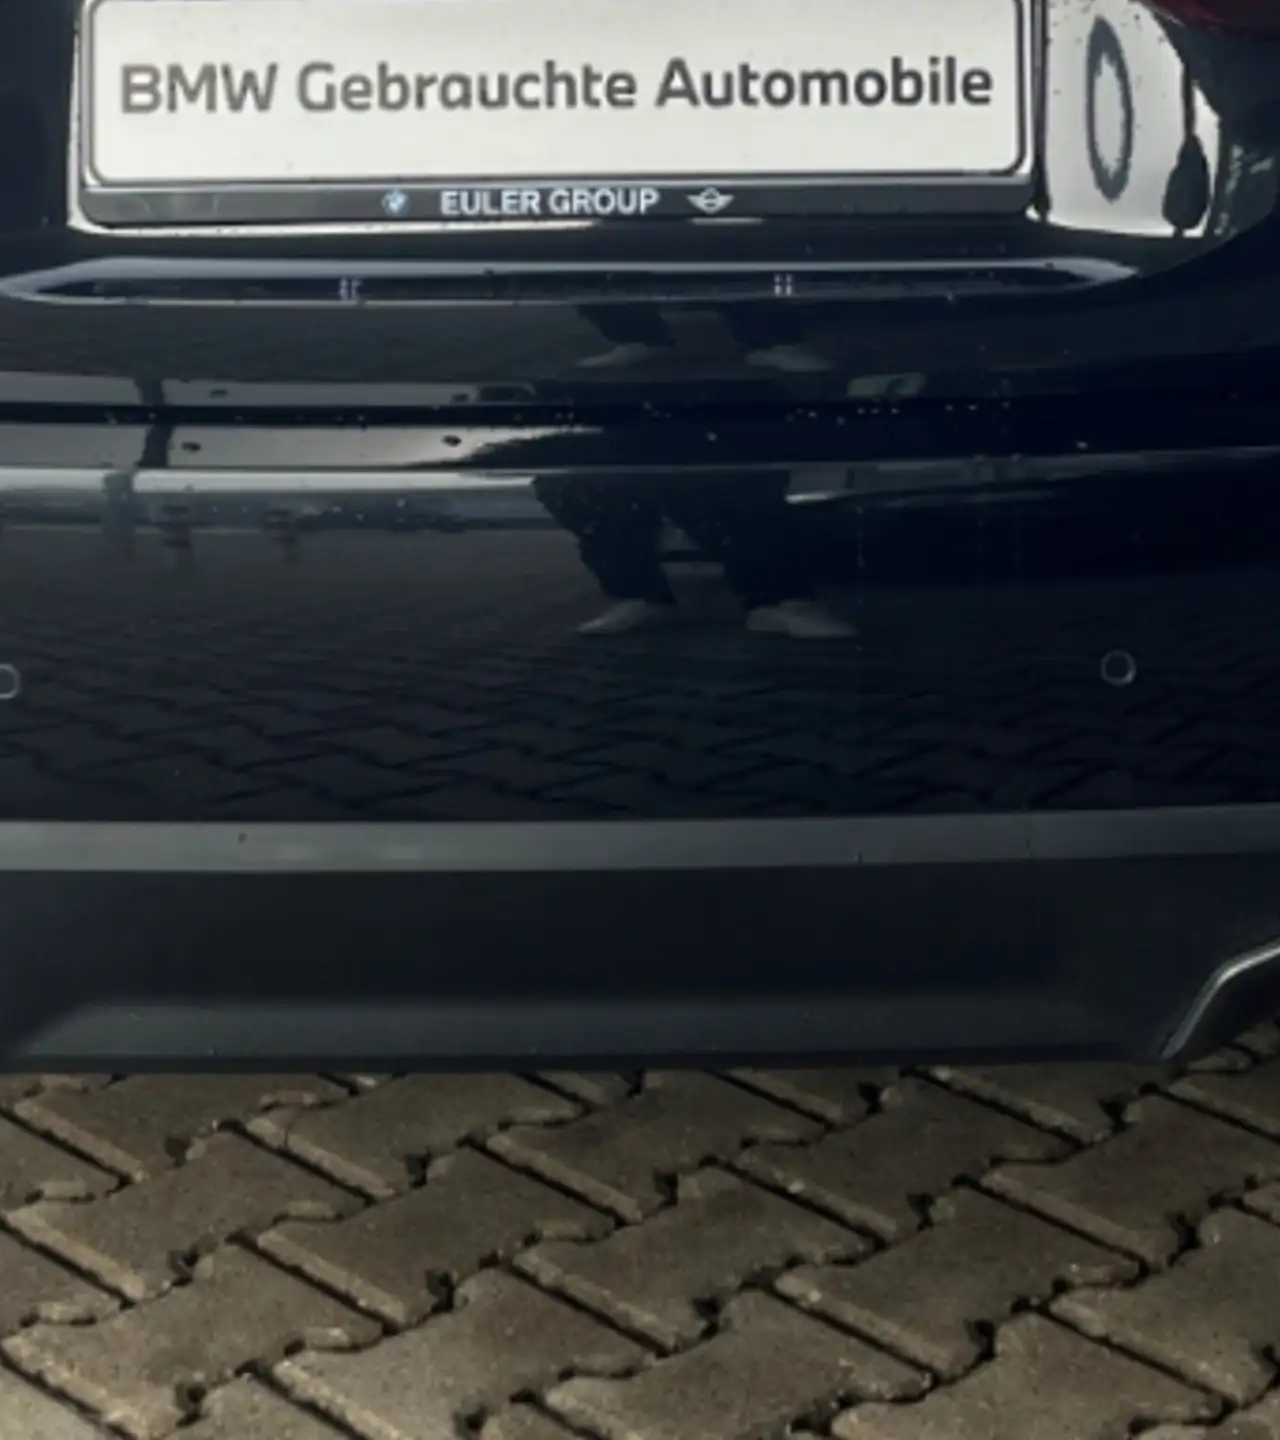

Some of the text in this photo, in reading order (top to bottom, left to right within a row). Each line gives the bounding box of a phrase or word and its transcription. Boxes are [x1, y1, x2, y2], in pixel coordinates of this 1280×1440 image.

[120, 55, 994, 114] BMW Gebrauchte Automobile
[439, 187, 660, 216] EULER GROUP
